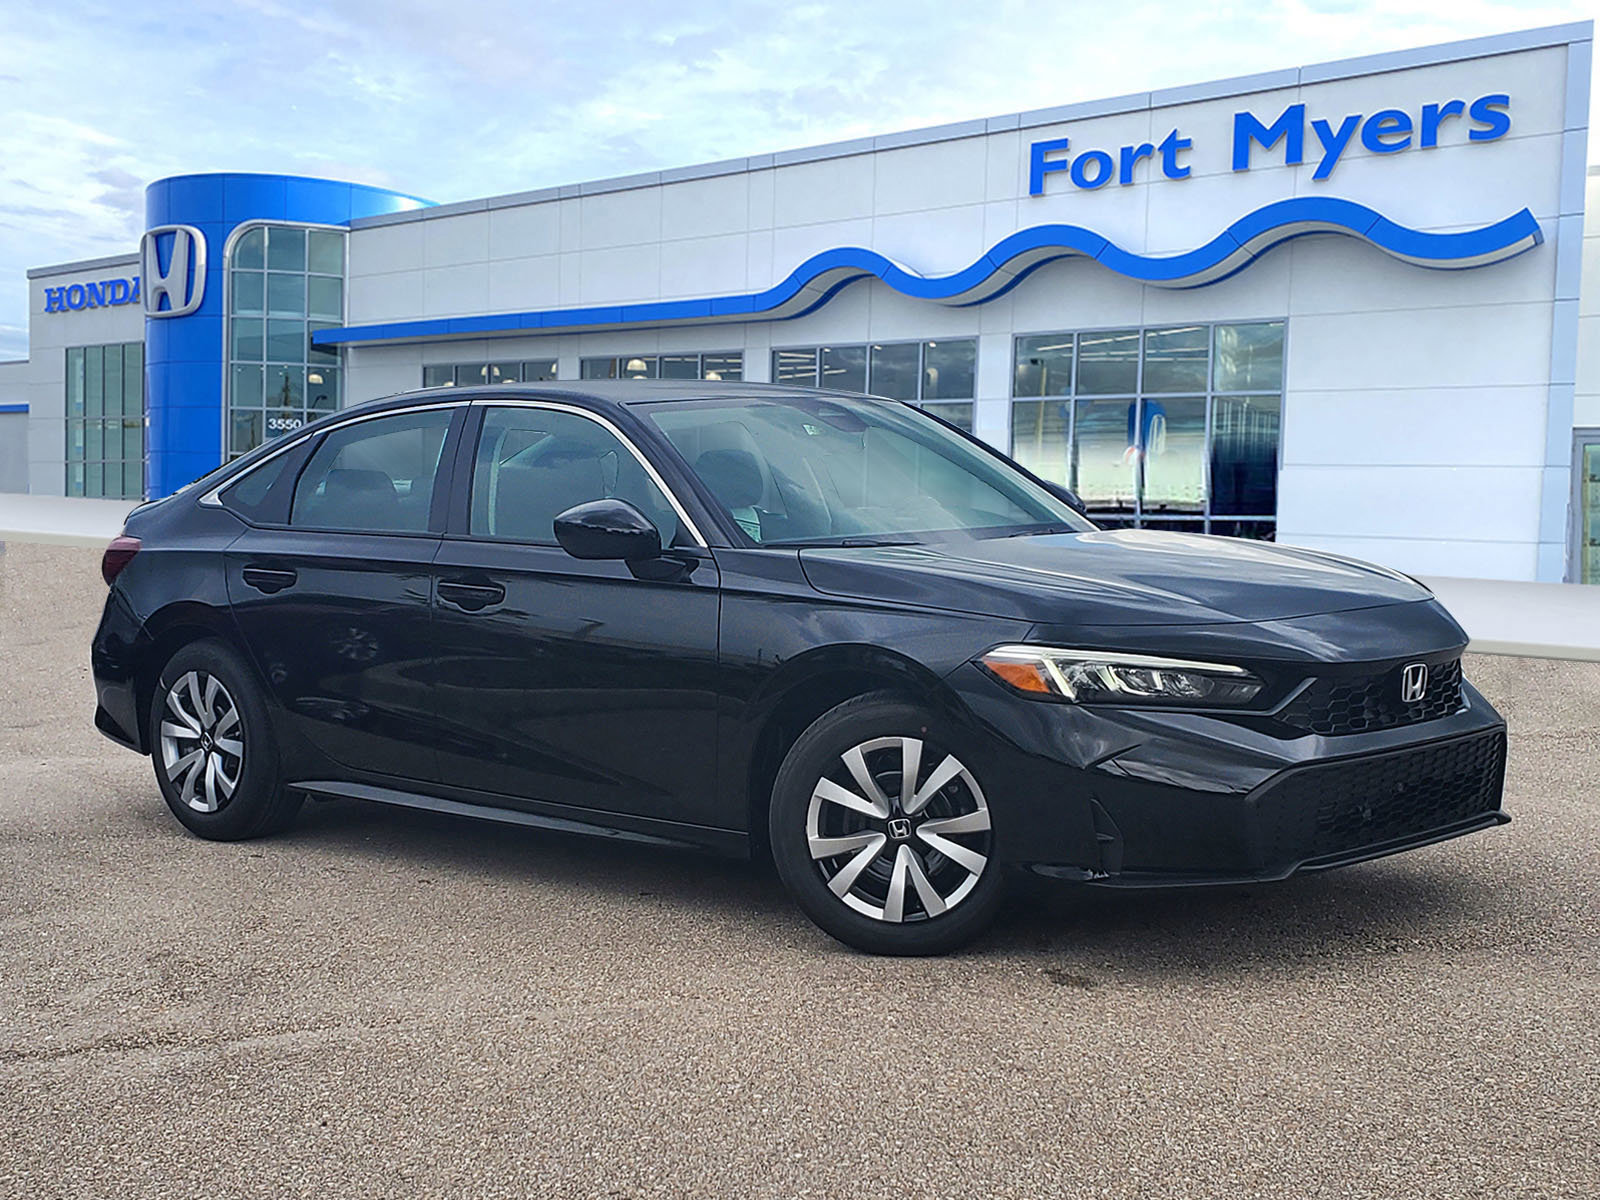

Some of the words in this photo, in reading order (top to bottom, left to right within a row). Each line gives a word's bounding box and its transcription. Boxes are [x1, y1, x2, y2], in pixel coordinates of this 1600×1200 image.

[1029, 128, 1193, 196] Fort
[1232, 93, 1511, 181] Myers
[268, 418, 302, 430] 3550
